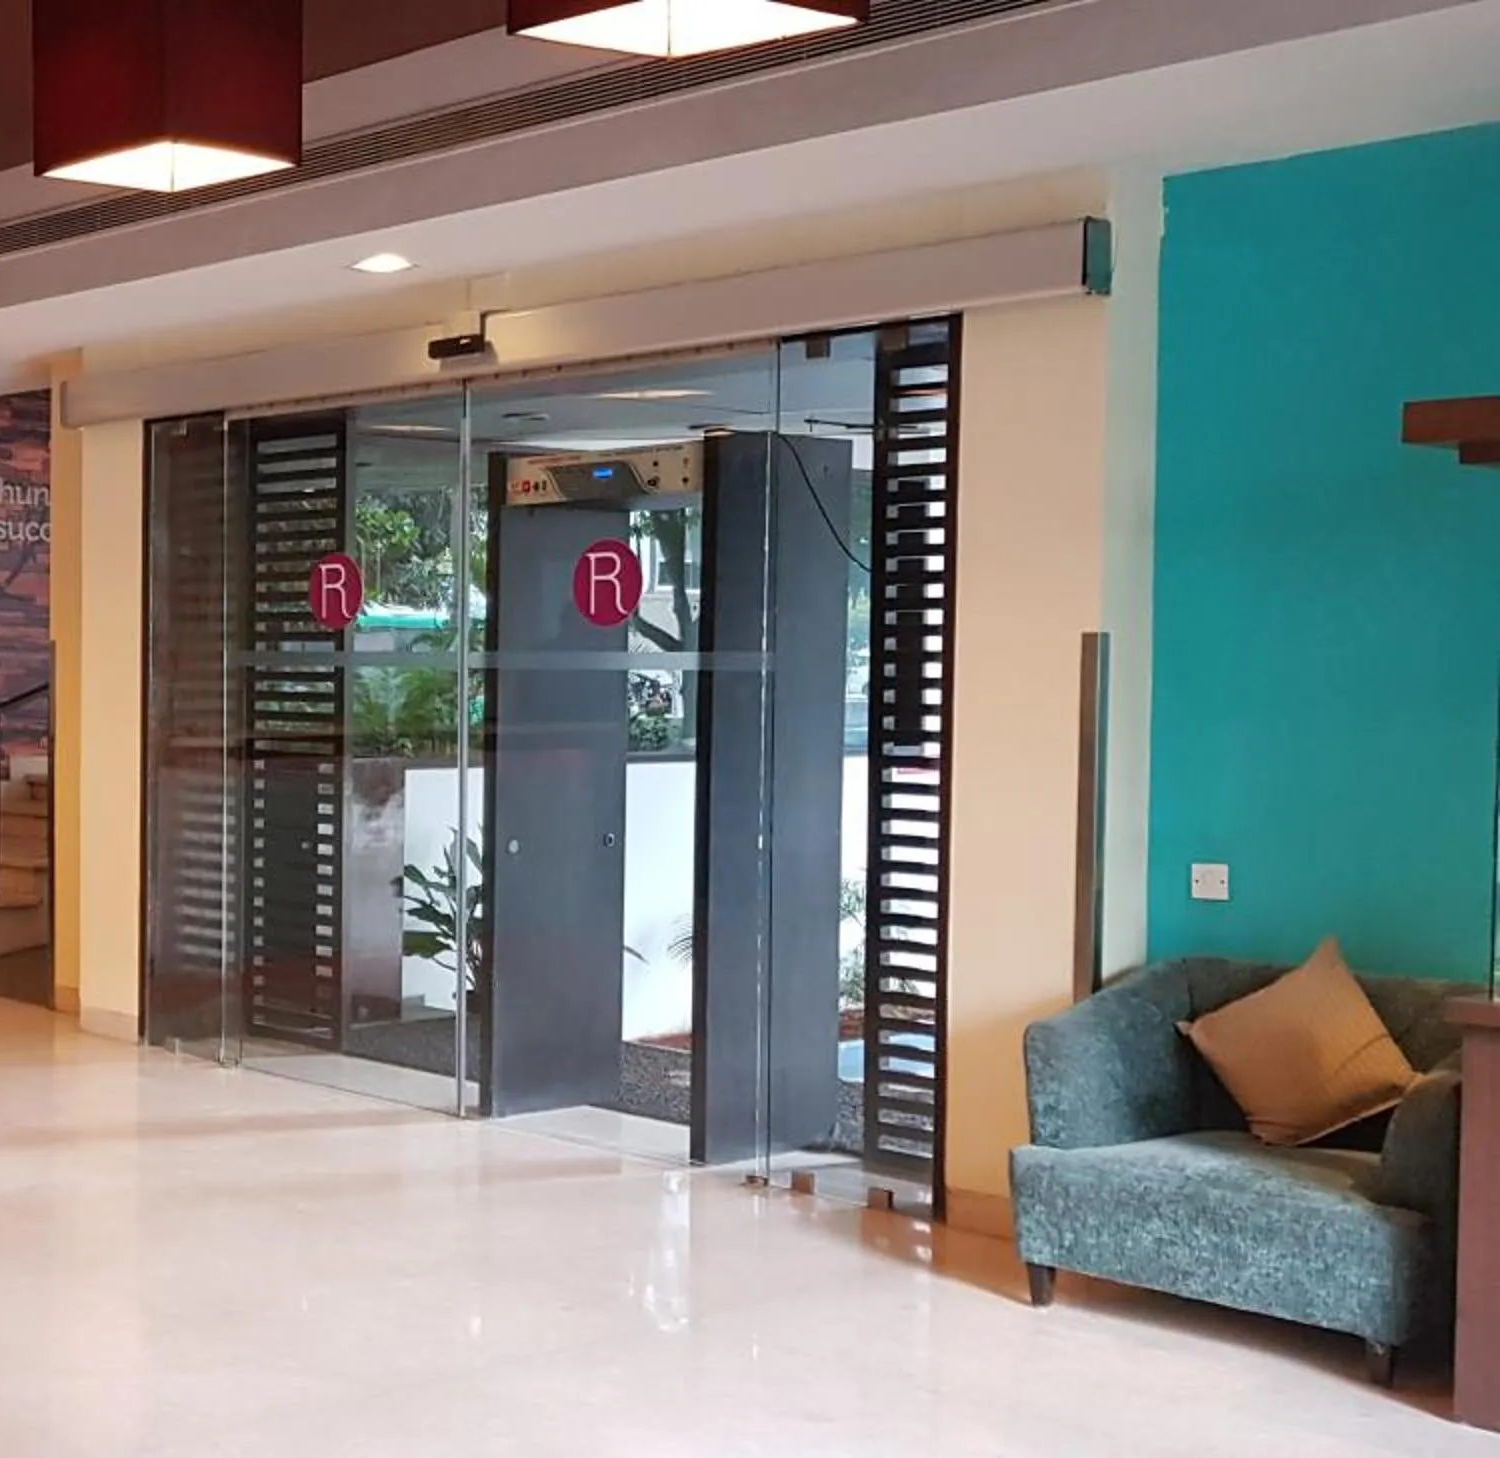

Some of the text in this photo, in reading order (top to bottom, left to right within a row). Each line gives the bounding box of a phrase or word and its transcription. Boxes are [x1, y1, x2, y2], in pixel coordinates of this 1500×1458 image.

[0, 477, 50, 505] hun
[318, 563, 350, 619] R
[585, 552, 628, 615] R
